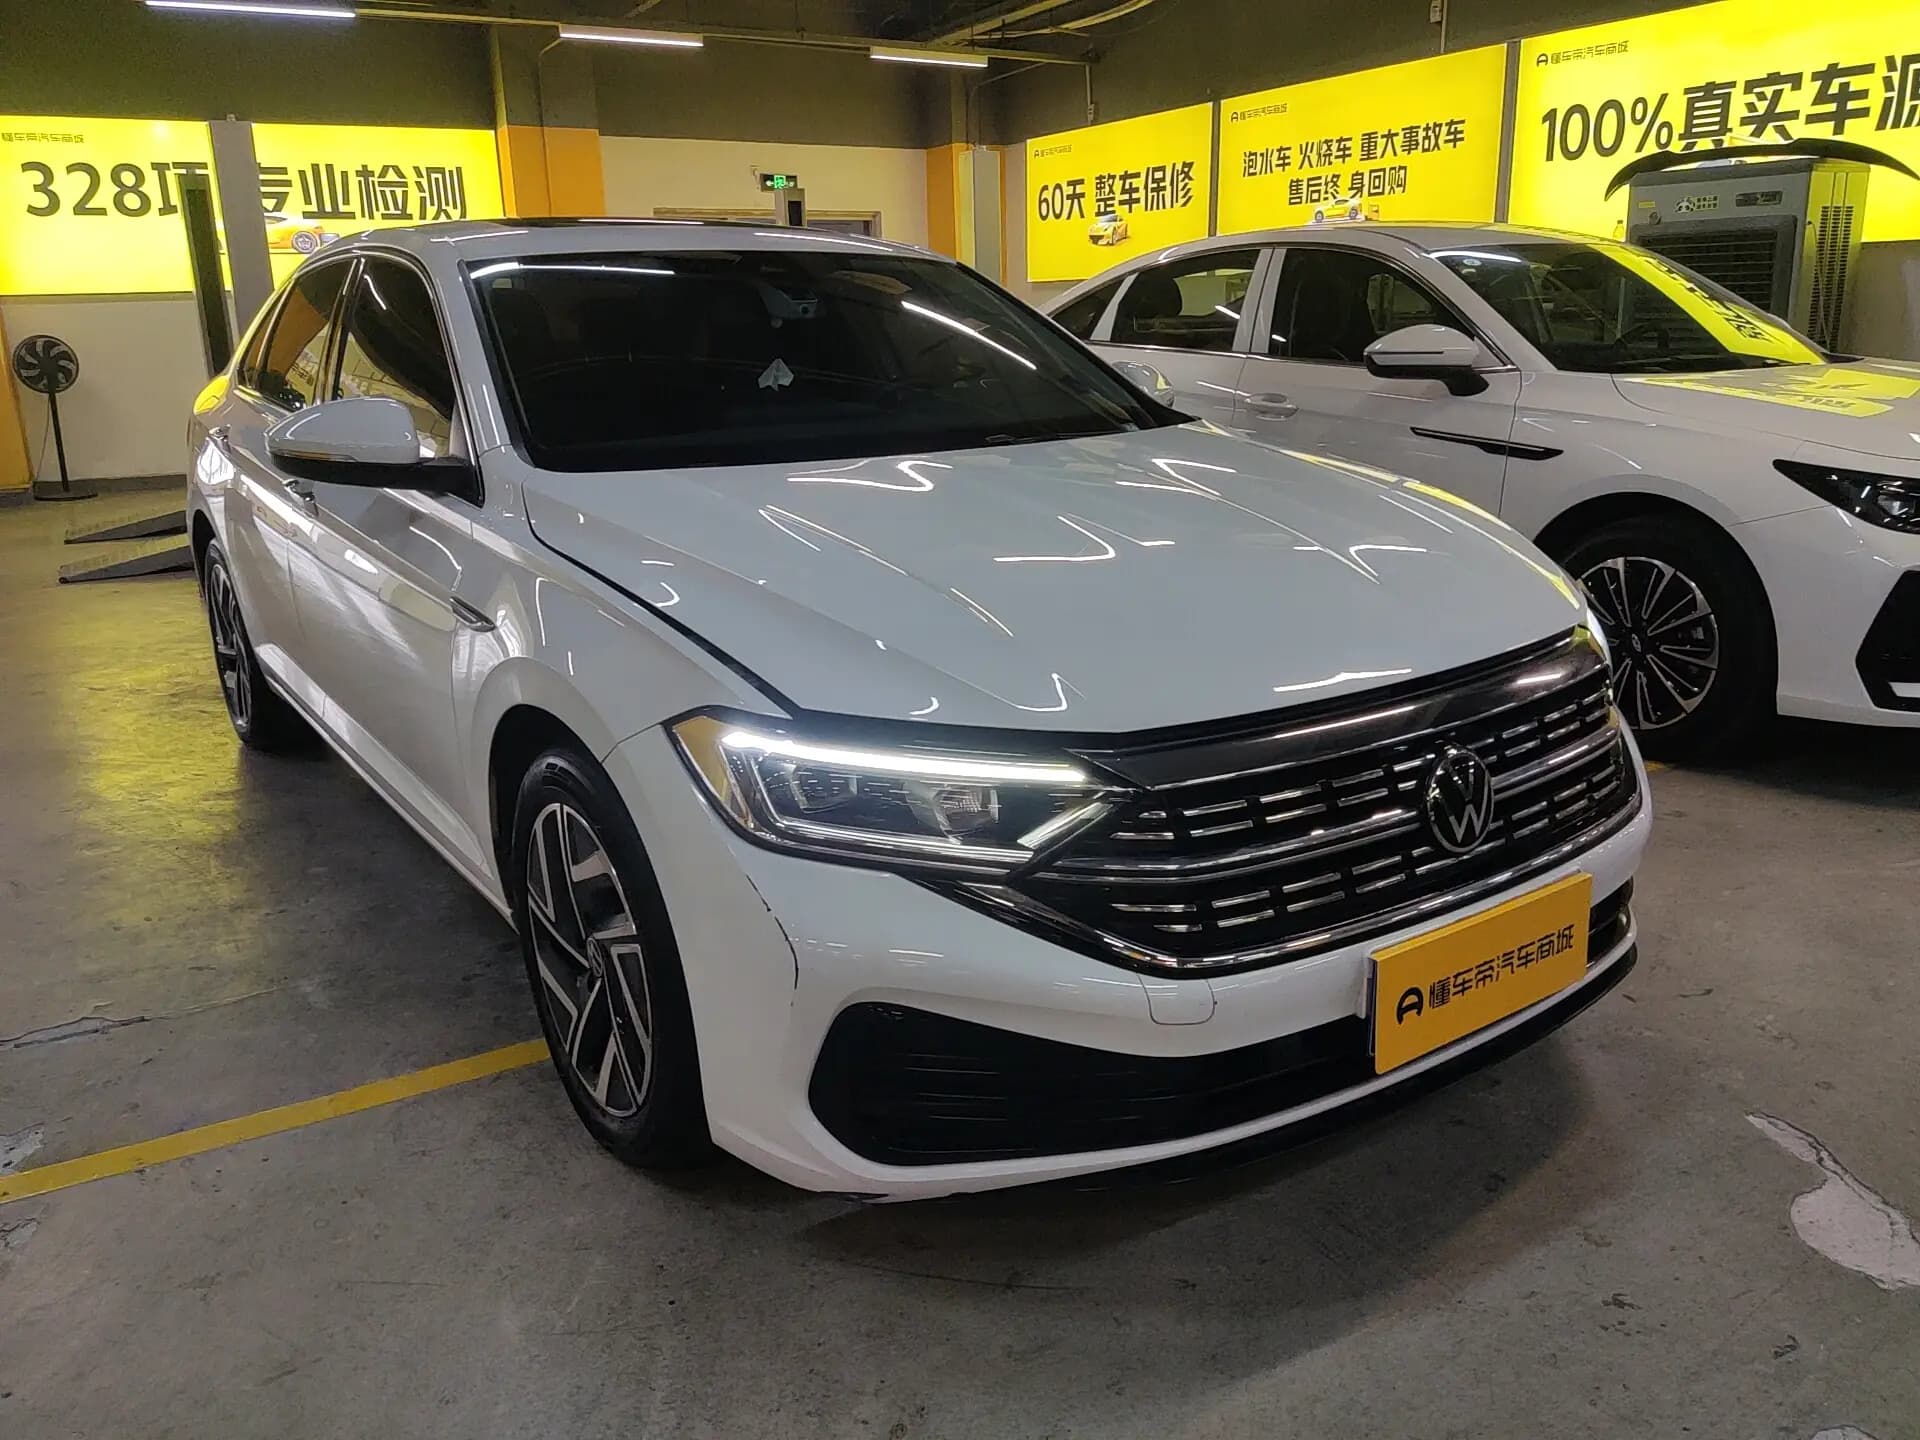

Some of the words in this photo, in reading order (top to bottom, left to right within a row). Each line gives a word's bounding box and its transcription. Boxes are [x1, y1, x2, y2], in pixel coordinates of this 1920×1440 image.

[1243, 146, 1292, 177] 泡水车
[1298, 136, 1352, 170] 火烧车
[1360, 119, 1466, 161] 重大事故车
[1038, 178, 1086, 221] 60天
[1094, 160, 1195, 217] 整车保修
[1428, 923, 1575, 1009] 懂车帝汽车商城
